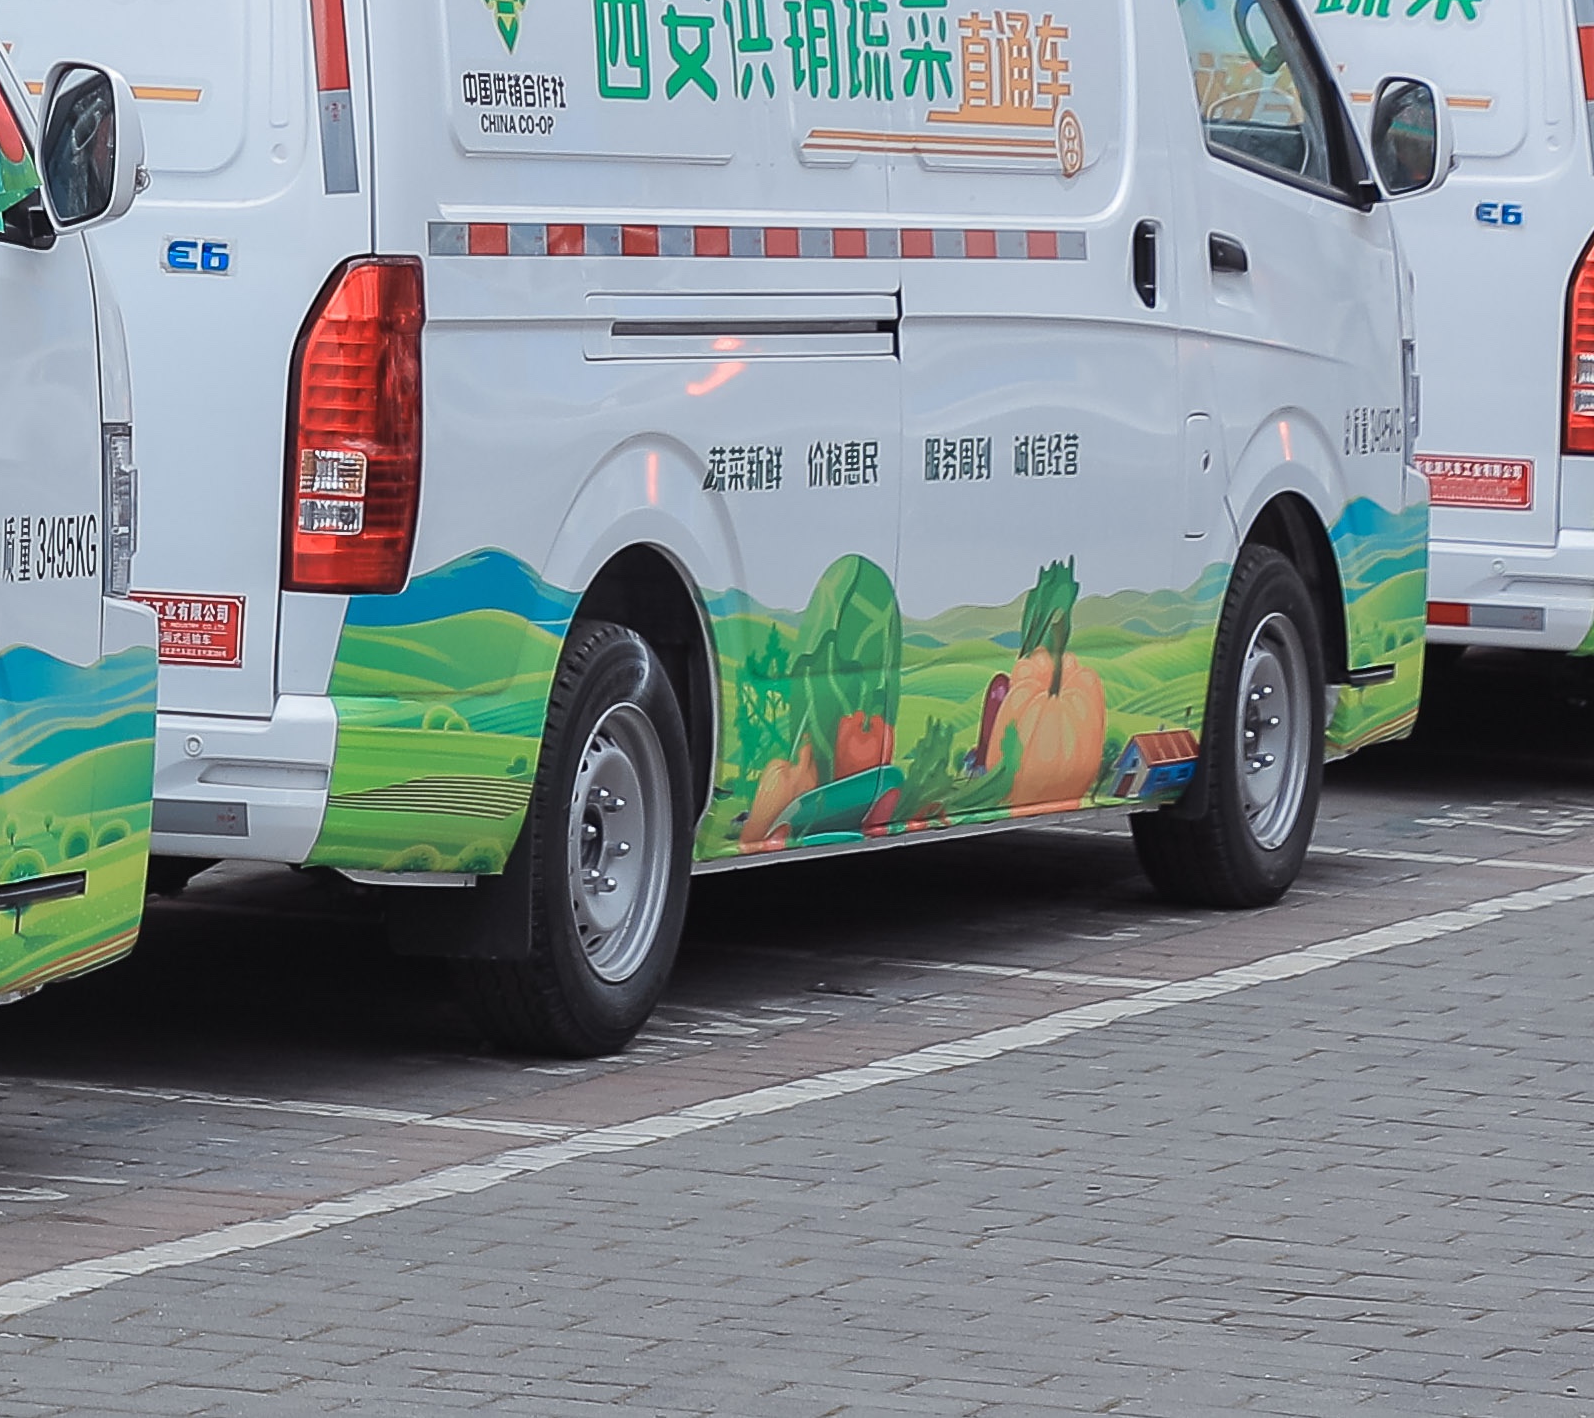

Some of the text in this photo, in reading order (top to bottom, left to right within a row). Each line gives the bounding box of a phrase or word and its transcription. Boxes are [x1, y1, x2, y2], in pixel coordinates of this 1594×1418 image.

[957, 10, 1071, 112] 直通车
[462, 71, 567, 110] 中国供销合作社
[480, 114, 556, 136] CHINA CO-OP
[702, 432, 1080, 491] 蔬菜新鲜 价格惠民 服务周到 诚信经营
